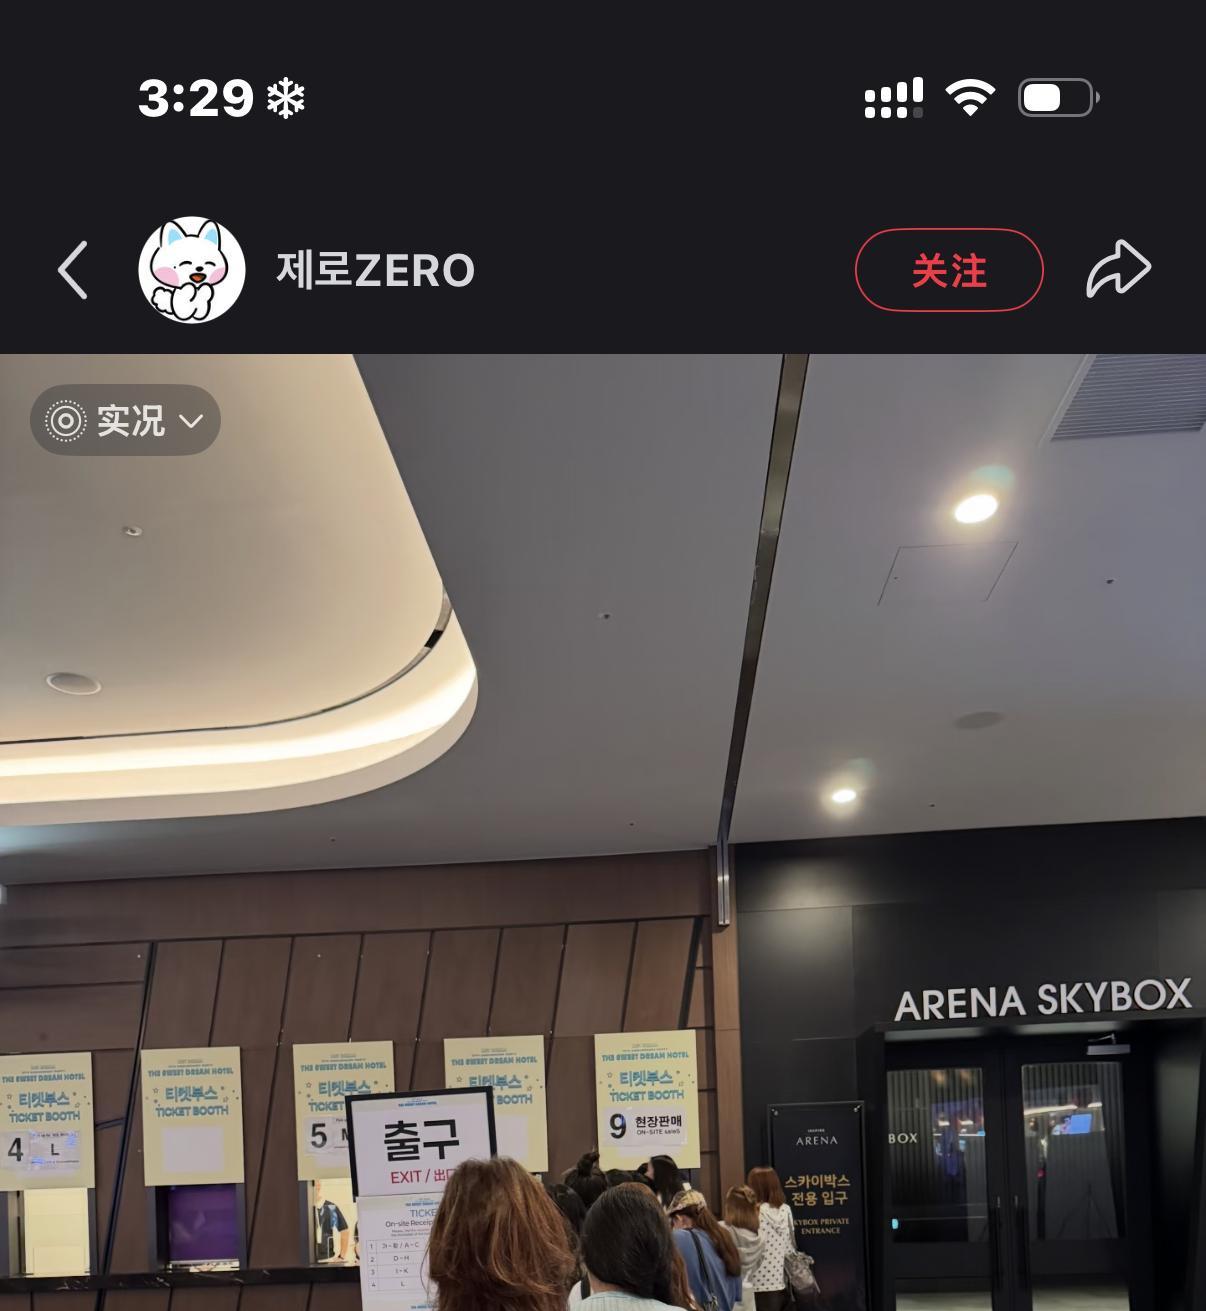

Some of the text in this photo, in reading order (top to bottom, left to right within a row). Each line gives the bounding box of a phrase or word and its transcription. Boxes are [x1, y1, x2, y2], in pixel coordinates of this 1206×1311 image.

[894, 977, 1193, 1022] ARENA SKYBOX
[620, 1070, 673, 1087] 티켓부스
[165, 1085, 218, 1103] 티켓부스
[318, 1080, 372, 1097] 티켓부스
[19, 1091, 70, 1108] 티켓부스
[496, 1094, 533, 1105] BOOTH
[610, 1089, 684, 1102] TICKET BOOTH
[155, 1104, 229, 1117] TICKET BOOTH
[308, 1101, 345, 1112] TICKET
[9, 1111, 80, 1123] TICKET BOOTH
[635, 1115, 682, 1128] 현장판매
[609, 1113, 627, 1139] 9
[311, 1123, 327, 1148] 5
[384, 1119, 460, 1162] 출구
[796, 1135, 839, 1146] ARENA
[888, 1132, 918, 1144] BOX
[7, 1137, 24, 1162] 4
[51, 1143, 60, 1156] L
[391, 1170, 422, 1184] EXIT
[784, 1174, 851, 1189] 스카이박스
[792, 1190, 848, 1206] 전용 입구
[385, 1220, 410, 1228] On-site
[820, 1217, 849, 1225] PRIVATE
[801, 1227, 840, 1235] ENTRANCE
